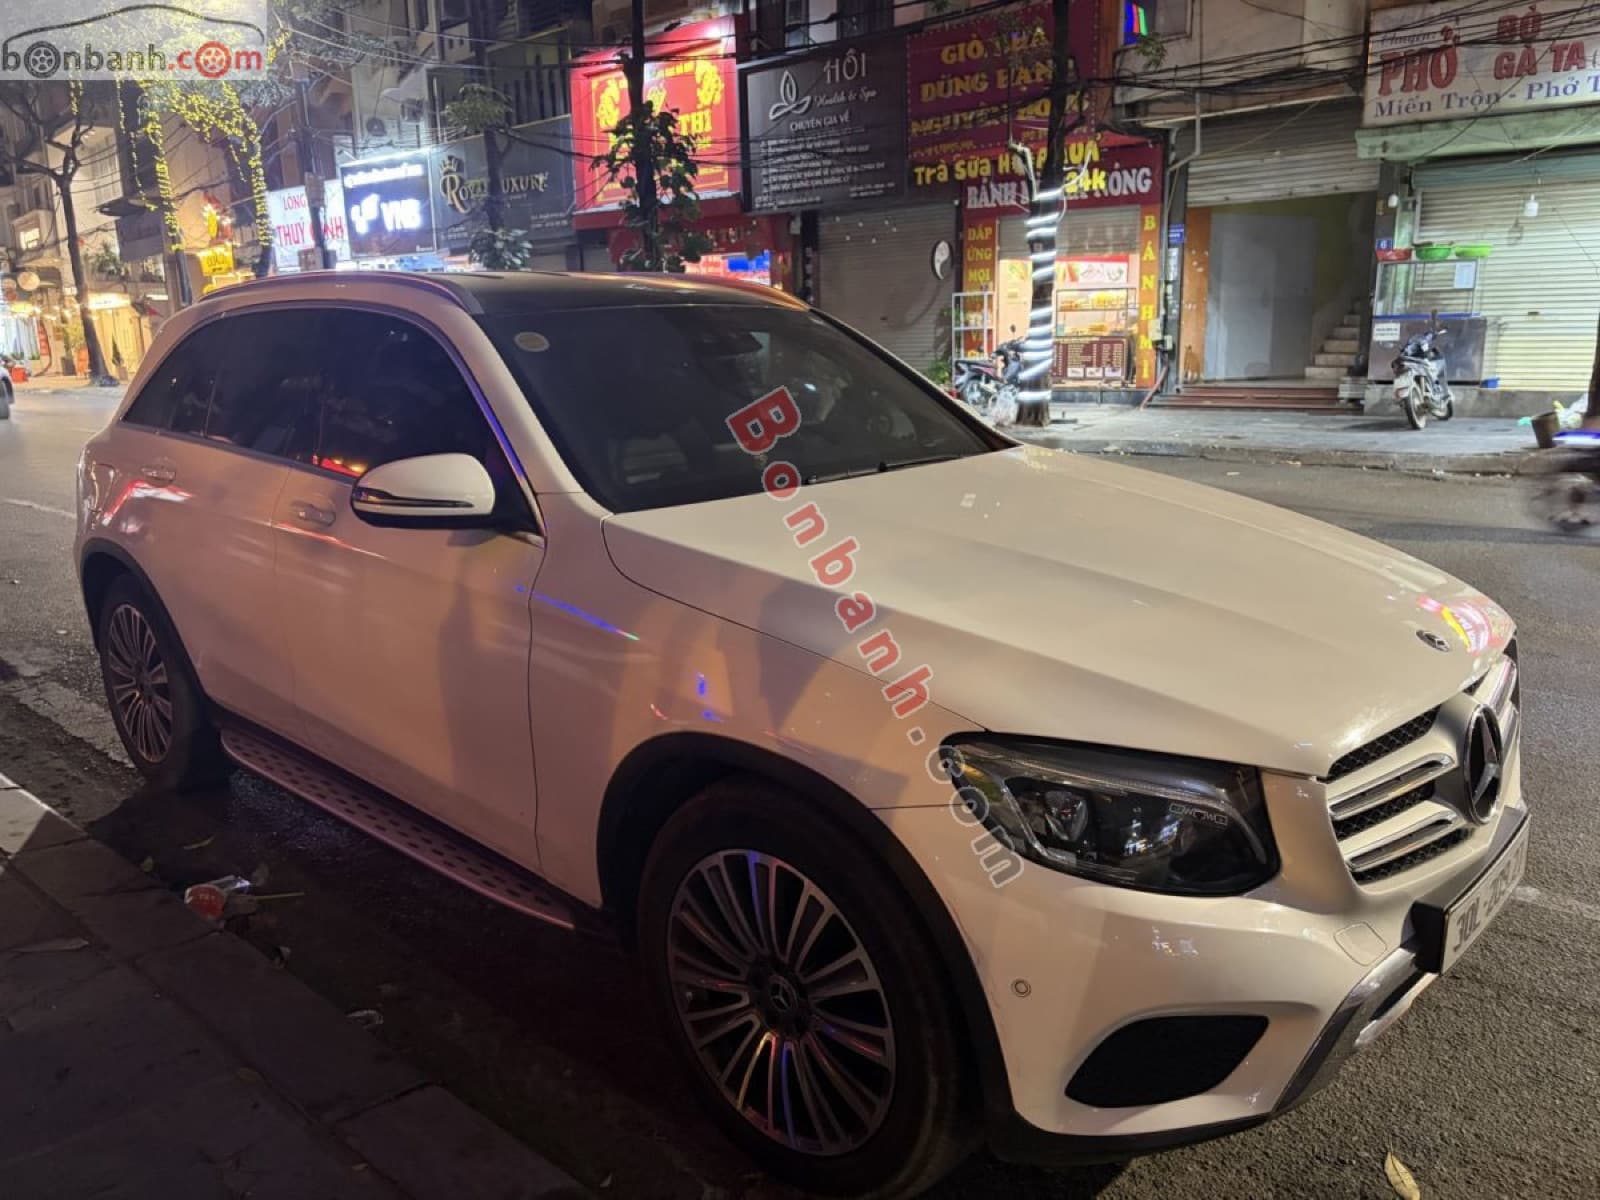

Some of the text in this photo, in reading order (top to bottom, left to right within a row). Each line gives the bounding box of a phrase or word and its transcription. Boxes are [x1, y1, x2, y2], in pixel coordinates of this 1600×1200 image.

[1494, 43, 1537, 80] GÀ
[1550, 41, 1586, 73] TA
[1441, 89, 1500, 112] Trộn
[1527, 76, 1580, 100] Phở
[1064, 132, 1102, 165] UẢ
[501, 170, 549, 193] UXURY
